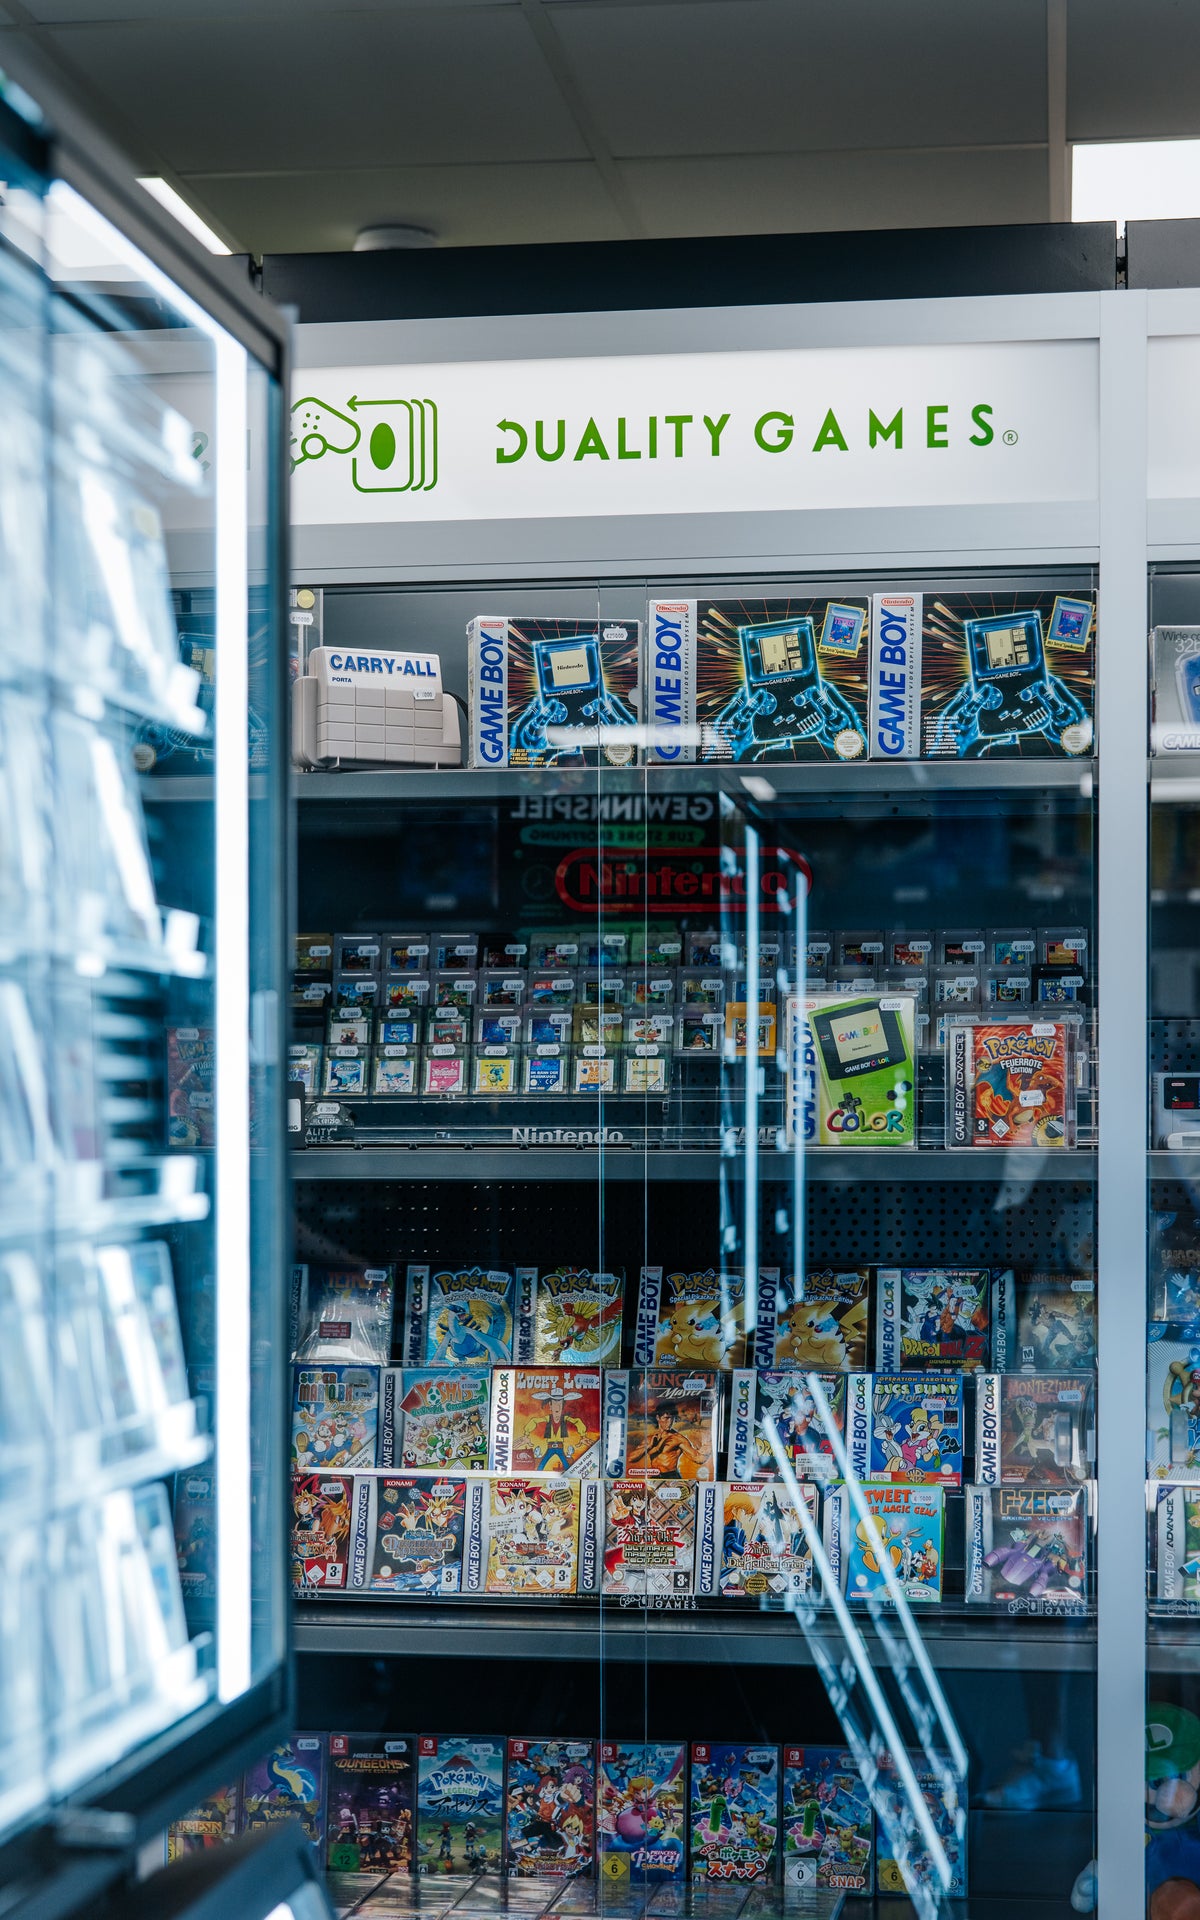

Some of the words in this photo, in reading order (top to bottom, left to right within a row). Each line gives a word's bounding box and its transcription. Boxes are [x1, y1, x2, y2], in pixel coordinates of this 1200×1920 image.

[496, 414, 732, 464] DUALITY
[655, 614, 682, 672] BOY
[880, 608, 907, 666] BOY
[1162, 631, 1188, 642] Wide
[330, 654, 437, 678] CARRY-ALL
[480, 631, 504, 685] BOY
[557, 663, 584, 671] Nintendo
[480, 686, 504, 763] GAME
[655, 676, 681, 760] GME
[877, 670, 906, 755] GAME
[955, 1034, 966, 1088] ADVANCE
[1000, 1058, 1043, 1070] FEUERROTE
[1010, 1067, 1033, 1075] EDITION
[955, 1088, 966, 1108] BOY
[827, 1109, 905, 1133] COLOR
[955, 1108, 966, 1141] GAME
[512, 1127, 623, 1143] Nintendo
[411, 1275, 424, 1312] COLOR
[520, 1277, 532, 1313] COLOR
[640, 1275, 659, 1310] BOY
[758, 1275, 777, 1312] BOY
[810, 1294, 833, 1302] Pikachu
[833, 1295, 854, 1305] Edition
[883, 1281, 895, 1318] COLOR
[998, 1279, 1006, 1327] ADVANCE
[410, 1312, 422, 1336] BOY
[519, 1314, 531, 1337] BOY
[883, 1318, 895, 1342] BOY
[997, 1327, 1006, 1347] BOY
[634, 1313, 658, 1366] GAME
[754, 1315, 776, 1369] GAME
[902, 1337, 941, 1357] DRAGON
[964, 1336, 986, 1359] Z
[1023, 1349, 1033, 1359] M
[300, 1372, 337, 1384] SUPER
[498, 1373, 510, 1405] COLOR
[516, 1372, 559, 1390] LUCKY
[638, 1373, 689, 1387] KUNG
[874, 1383, 911, 1395] BUGS
[914, 1383, 959, 1395] BUNNY
[385, 1375, 395, 1424] ADVANCE
[607, 1379, 626, 1418] BOY
[656, 1387, 706, 1399] Master
[737, 1380, 750, 1418] COLOR
[855, 1377, 865, 1410] COLOR
[984, 1377, 995, 1410] COLOR
[496, 1405, 510, 1435] BOY
[735, 1418, 748, 1444] BOY
[853, 1410, 867, 1437] BOY
[982, 1410, 997, 1440] BOY
[384, 1424, 395, 1446] BOY
[494, 1436, 510, 1475] GAME
[982, 1441, 997, 1485] GAME
[358, 1485, 369, 1536] ADVANCE
[472, 1488, 482, 1540] ADVANCE
[586, 1487, 597, 1538] ADVANCE
[882, 1505, 911, 1514] MAGIC
[914, 1506, 938, 1517] GEMS
[1000, 1489, 1075, 1516] F-ZERO
[704, 1490, 715, 1542] ADVANCE
[831, 1497, 843, 1546] ADVANCE
[974, 1495, 984, 1545] ADVANCE
[355, 1537, 366, 1558] BOY
[470, 1540, 481, 1560] BOY
[585, 1538, 596, 1559] BOY
[703, 1542, 714, 1562] BOY
[831, 1546, 842, 1567] BOY
[973, 1546, 983, 1566] BOY
[353, 1557, 365, 1587] GAME
[468, 1560, 480, 1590] GAME
[583, 1559, 595, 1589] GAME
[729, 1559, 742, 1569] Die
[742, 1556, 779, 1570] Heiligen
[701, 1562, 713, 1593] GAME
[973, 1566, 983, 1595] GAME
[338, 1759, 404, 1769] DUNGEONS
[426, 1797, 496, 1818] アルセウス
[340, 1855, 350, 1865] 12
[630, 1848, 682, 1869] PEACH
[720, 1847, 759, 1861] ポケモン
[611, 1863, 618, 1874] 6
[707, 1859, 766, 1879] スナップ
[797, 1870, 804, 1879] 0
[829, 1875, 866, 1888] SNAP
[891, 1870, 898, 1881] 6
